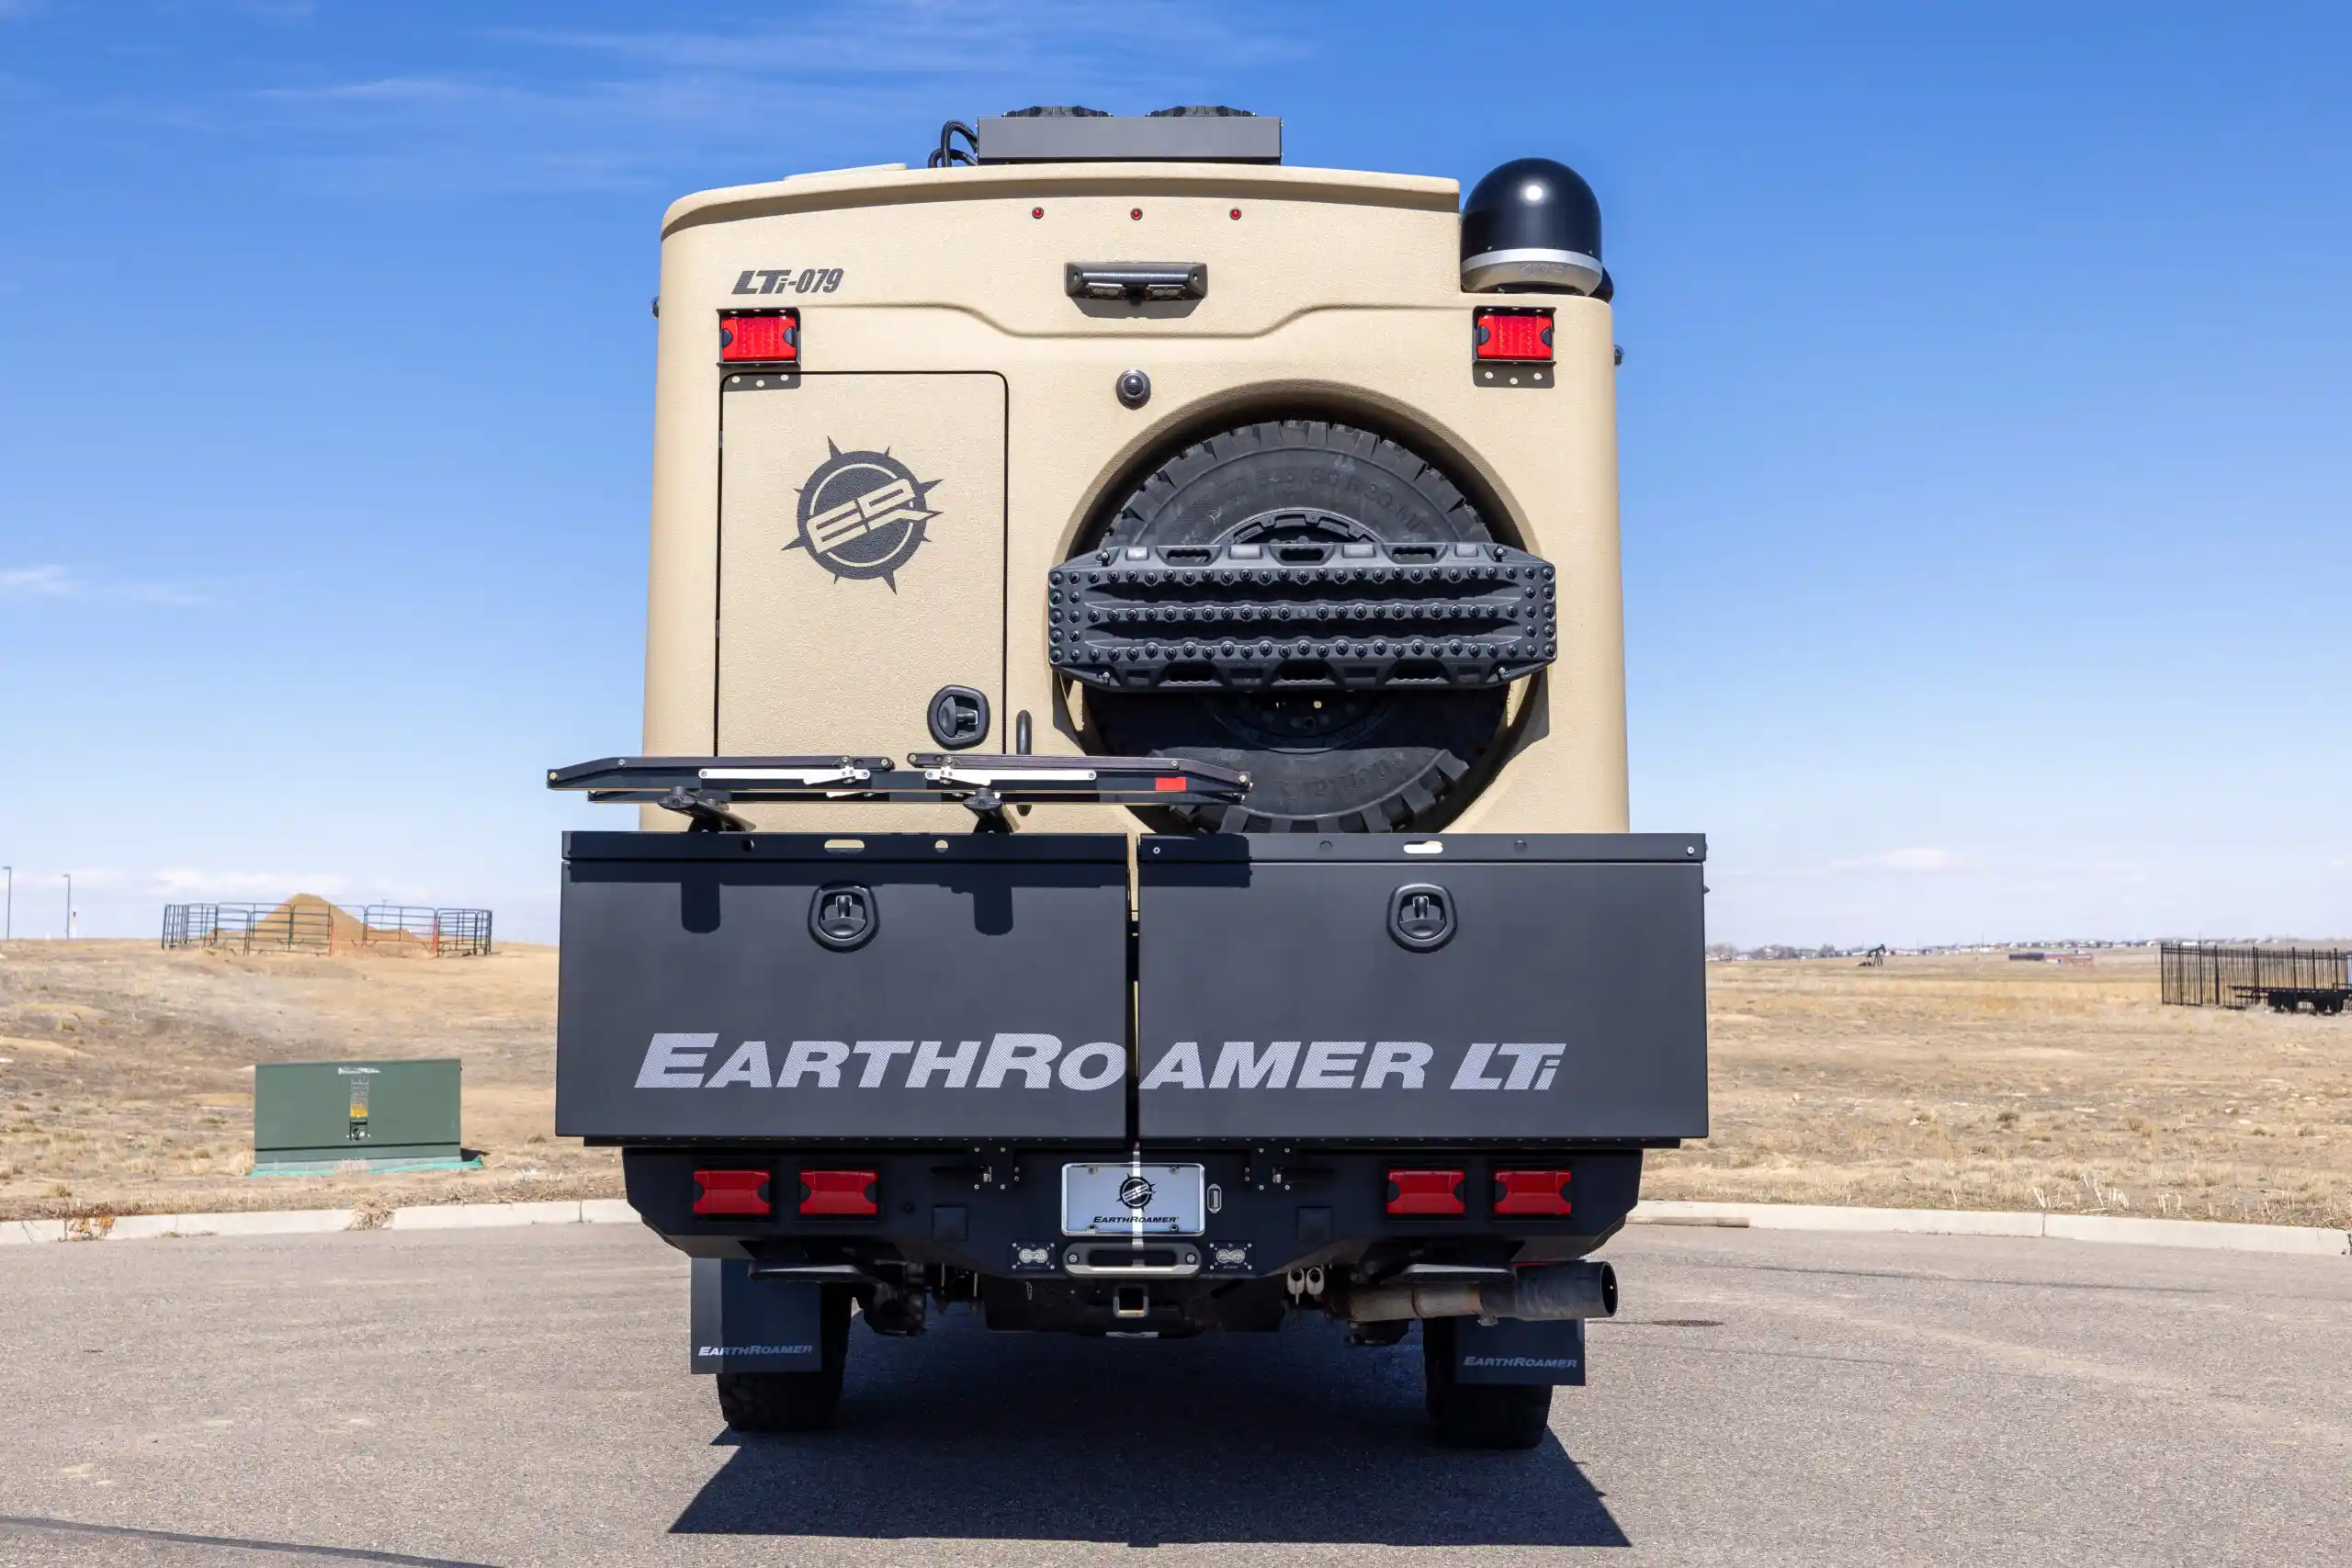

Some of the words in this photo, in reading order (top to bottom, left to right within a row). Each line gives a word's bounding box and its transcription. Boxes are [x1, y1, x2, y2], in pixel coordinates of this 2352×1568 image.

[730, 267, 844, 294] LTi-079
[1449, 1043, 1567, 1091] LTi
[697, 1345, 813, 1357] EARTHROAMER
[1463, 1356, 1578, 1369] EARTHROAMER
